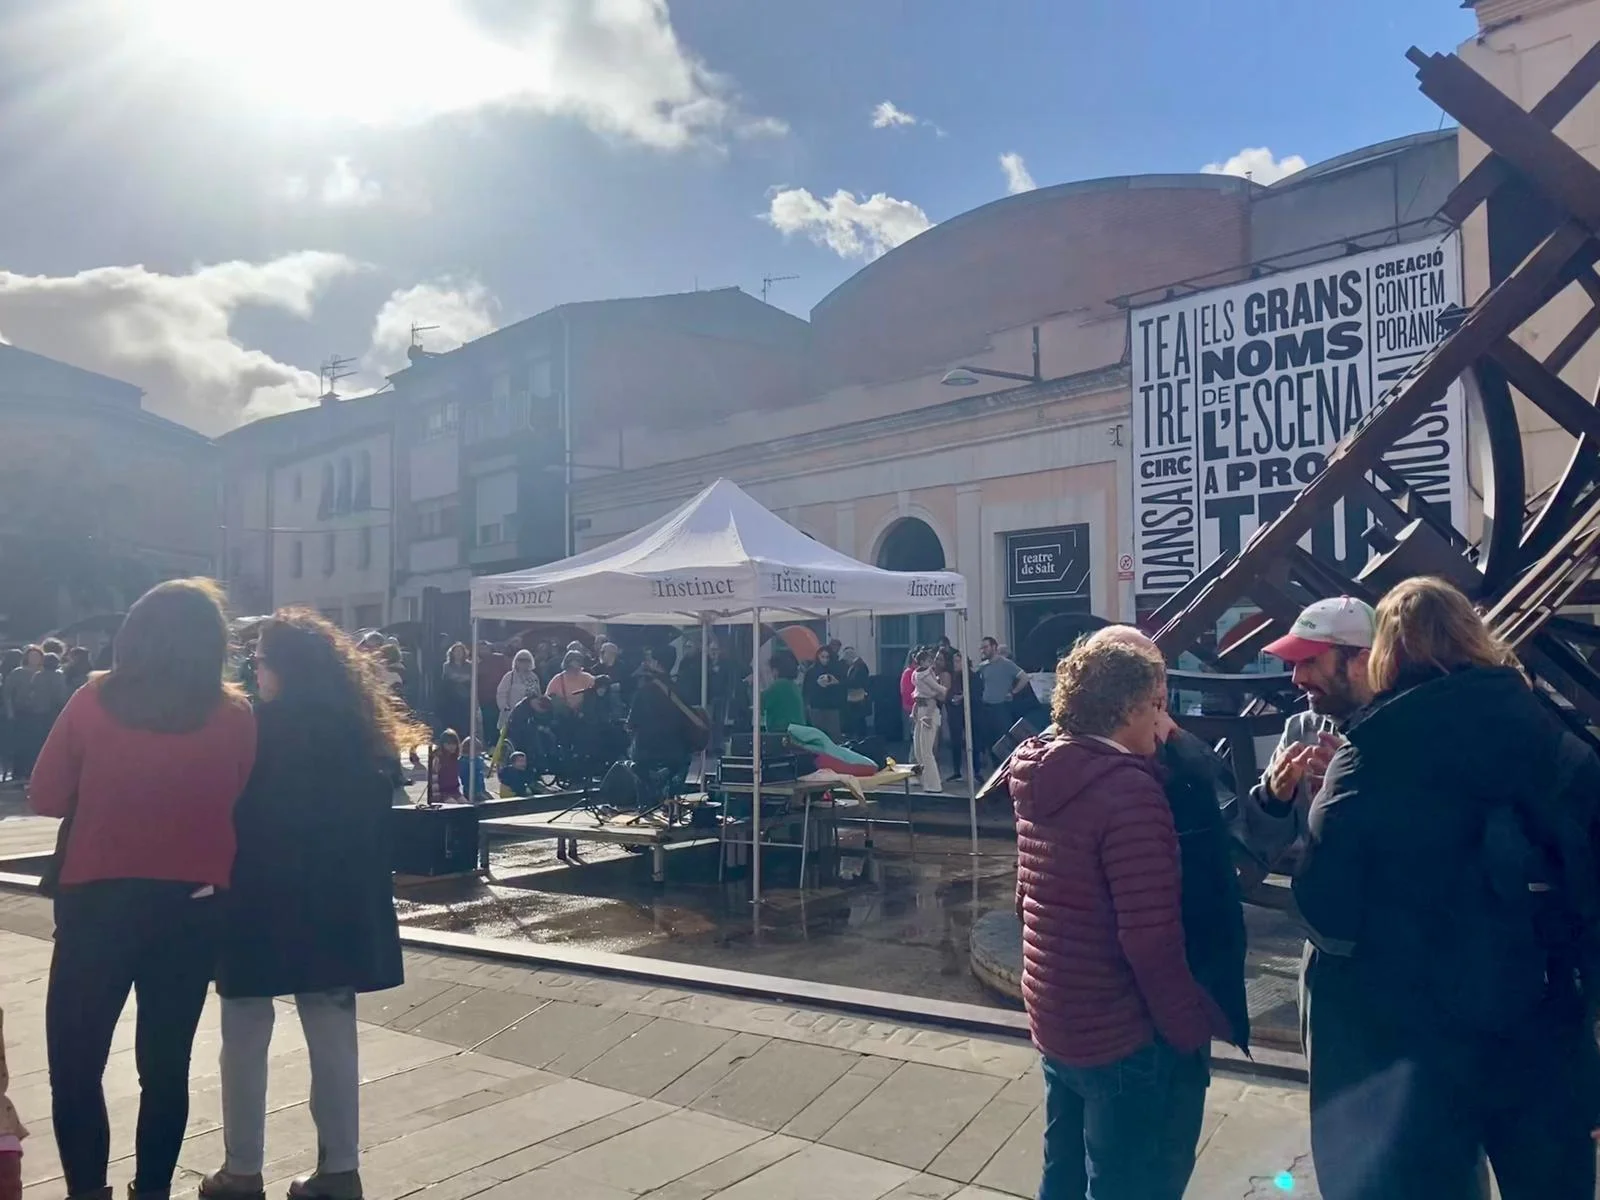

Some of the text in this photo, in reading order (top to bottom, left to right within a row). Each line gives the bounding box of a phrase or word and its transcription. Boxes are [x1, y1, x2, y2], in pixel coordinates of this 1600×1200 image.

[1375, 246, 1444, 279] CREACIÓ
[1376, 269, 1445, 316] CONTEM
[1201, 270, 1362, 346] ELS GRANS
[1139, 311, 1190, 382] TEA
[1202, 321, 1364, 383] NOMS
[1203, 385, 1231, 406] DE
[1139, 378, 1192, 448] TRE
[1141, 455, 1192, 479] CIRC
[1204, 466, 1219, 494] A
[1141, 487, 1195, 590] DANSA
[1021, 562, 1055, 575] de Salt
[1023, 553, 1053, 564] teatre
[656, 576, 735, 597] Instinct
[776, 573, 836, 594] Instinct
[910, 580, 956, 597] Instinct
